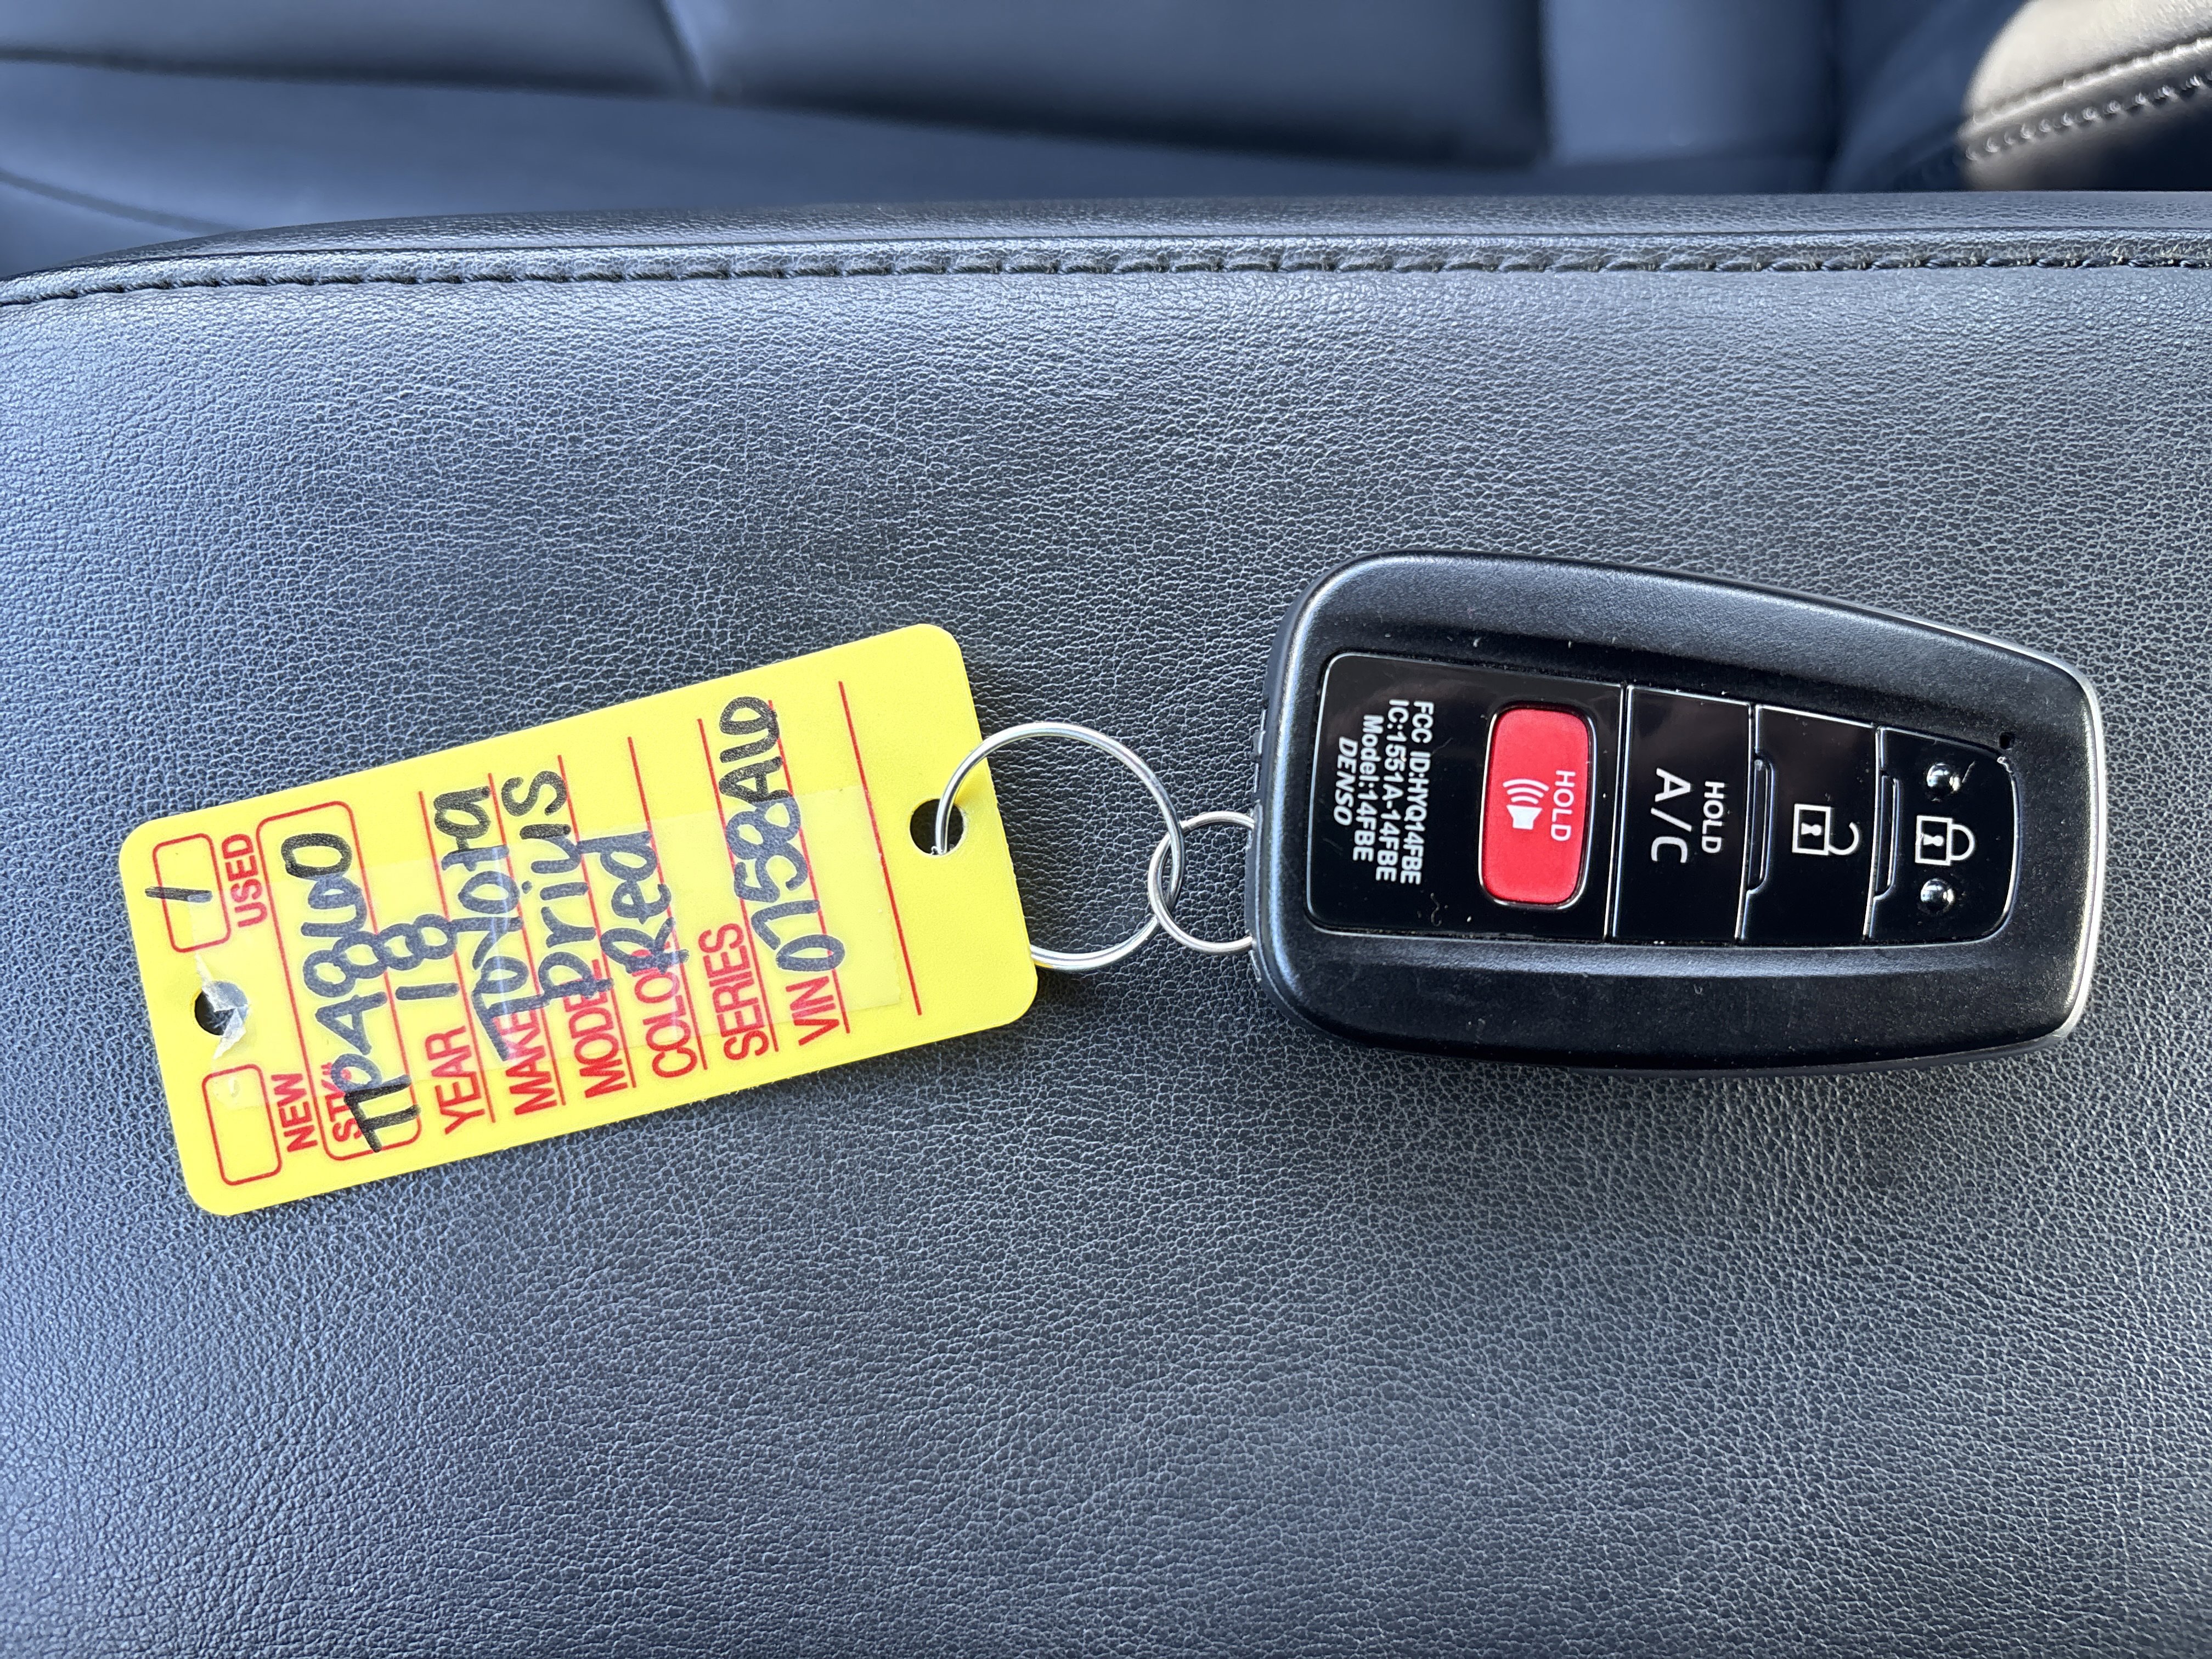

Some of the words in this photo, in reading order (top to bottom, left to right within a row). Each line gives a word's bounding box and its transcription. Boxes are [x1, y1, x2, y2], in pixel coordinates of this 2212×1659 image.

[1410, 700, 1435, 744] FCC
[1333, 736, 1358, 826] DENSO
[1352, 714, 1385, 862] Model:14FBE
[1375, 699, 1410, 882] IC:1551A-14FBE
[1400, 750, 1432, 885] ID:HYQ14FBE
[1550, 770, 1576, 842] HOLD
[1650, 767, 1692, 864] A/C
[1701, 780, 1726, 854] HOLD
[221, 833, 268, 928] USED
[600, 830, 691, 974] Red
[373, 913, 460, 1000] 18
[697, 922, 770, 1061] SERIES
[785, 975, 840, 1047] VIN
[425, 1025, 486, 1136] YEAR
[492, 1008, 558, 1117] MAKE
[270, 1072, 319, 1154] NEW
